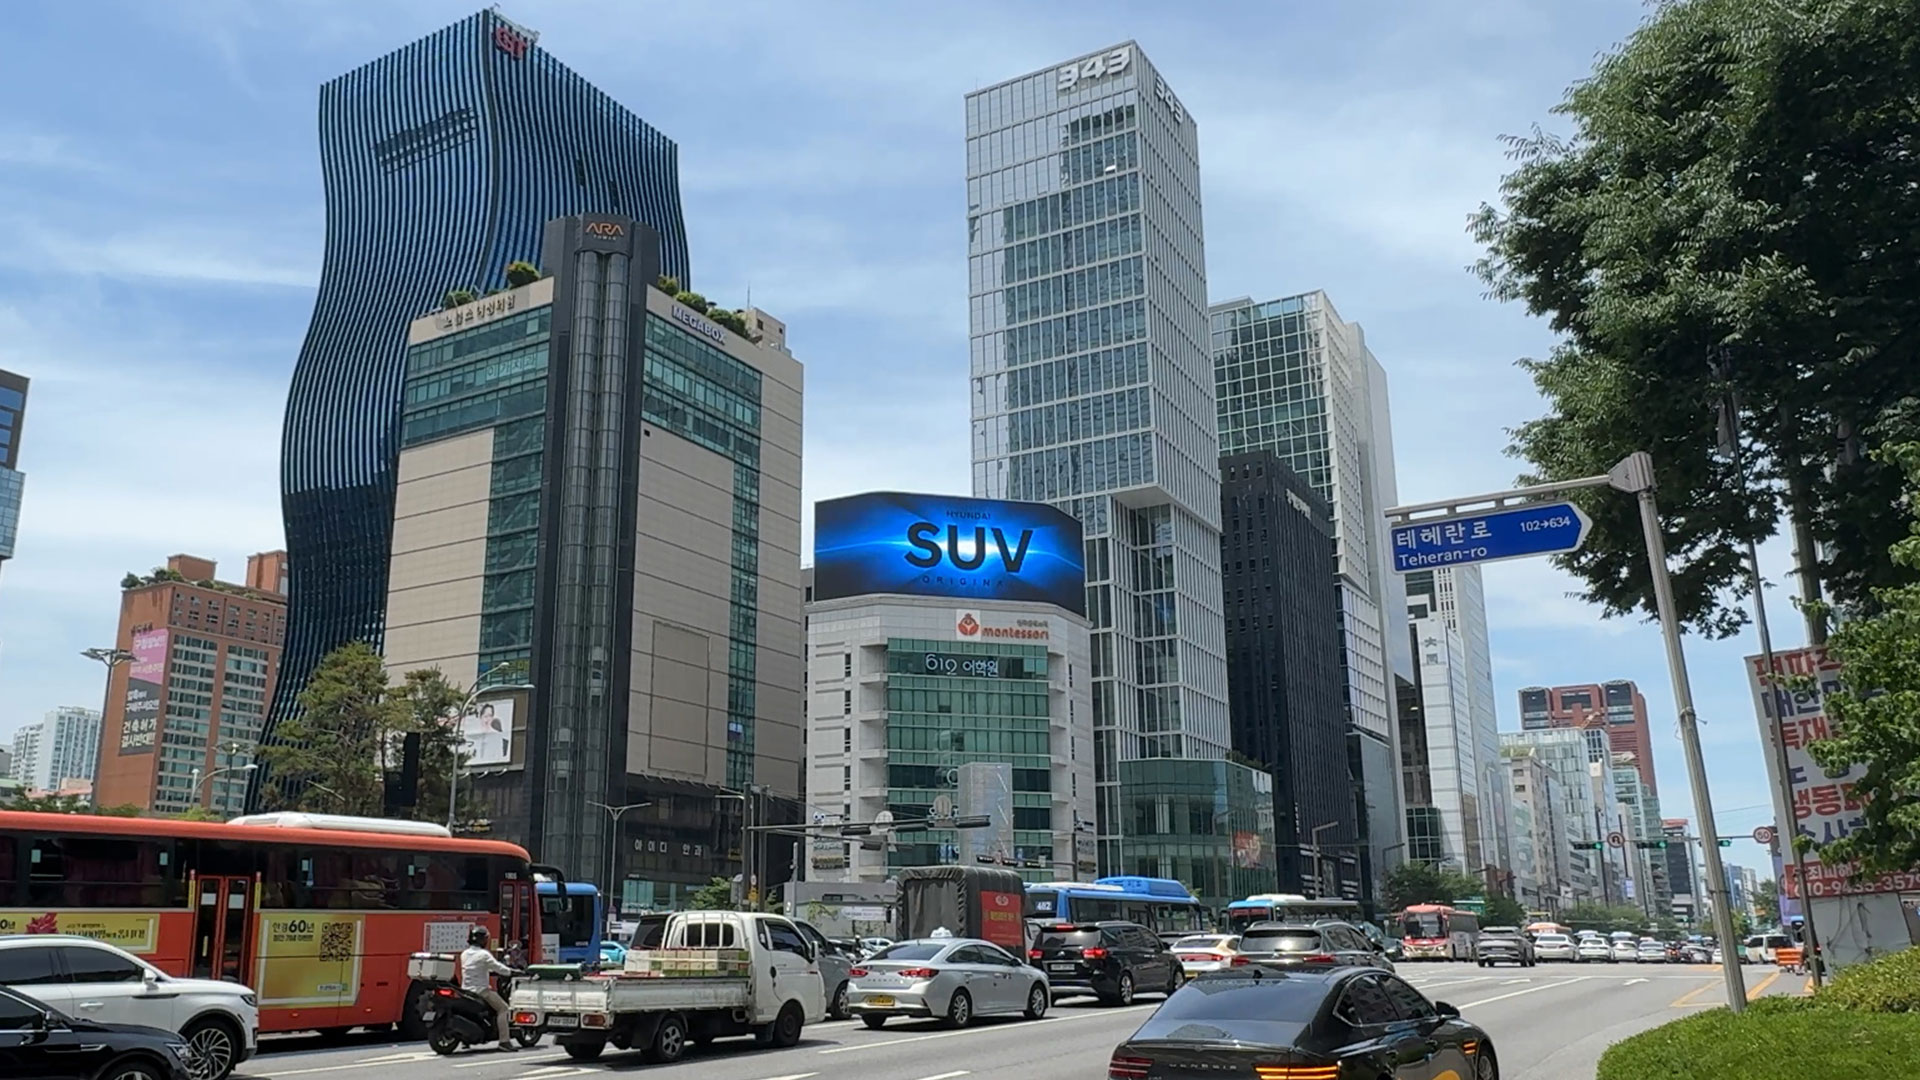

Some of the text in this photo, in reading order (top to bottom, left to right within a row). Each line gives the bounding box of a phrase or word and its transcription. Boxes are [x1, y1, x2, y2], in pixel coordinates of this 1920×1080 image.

[496, 27, 528, 58] GT
[1058, 45, 1131, 90] 343
[1155, 75, 1183, 123] 343
[585, 222, 624, 236] ARA
[672, 304, 726, 346] MEGABOX
[946, 510, 991, 520] HYUNDAI
[1396, 520, 1492, 550] 테헤란로
[904, 521, 1034, 573] SUV
[1399, 547, 1488, 568] Teheran-ro
[982, 627, 1049, 640] montessori
[962, 660, 999, 678] 어학원
[1757, 830, 1770, 840] 50
[634, 839, 702, 856] 아이디 안과
